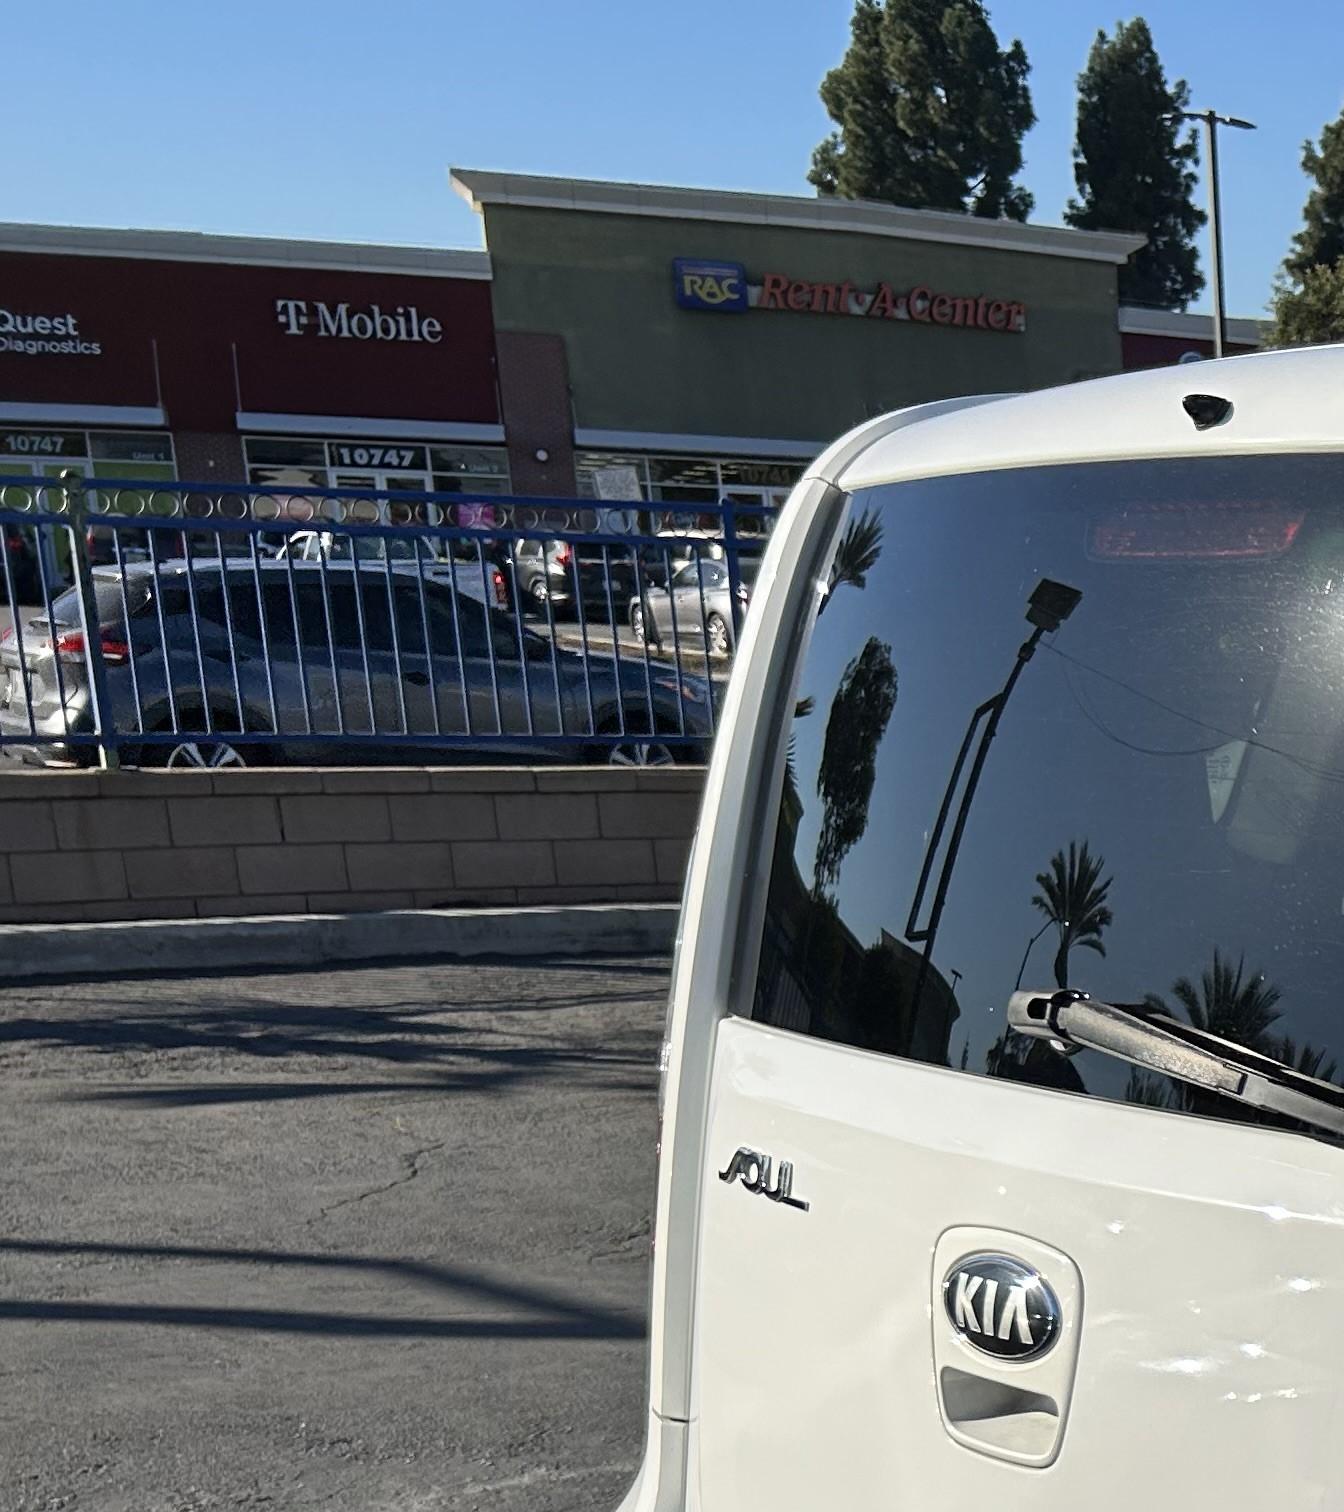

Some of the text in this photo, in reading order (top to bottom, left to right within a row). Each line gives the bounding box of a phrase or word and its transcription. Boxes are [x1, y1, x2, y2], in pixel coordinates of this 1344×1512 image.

[683, 275, 740, 304] RAC
[0, 310, 79, 335] Quest
[5, 434, 65, 453] 10747
[340, 447, 415, 467] 10747
[719, 1147, 810, 1213] SOUL
[955, 1272, 1034, 1345] KIA
